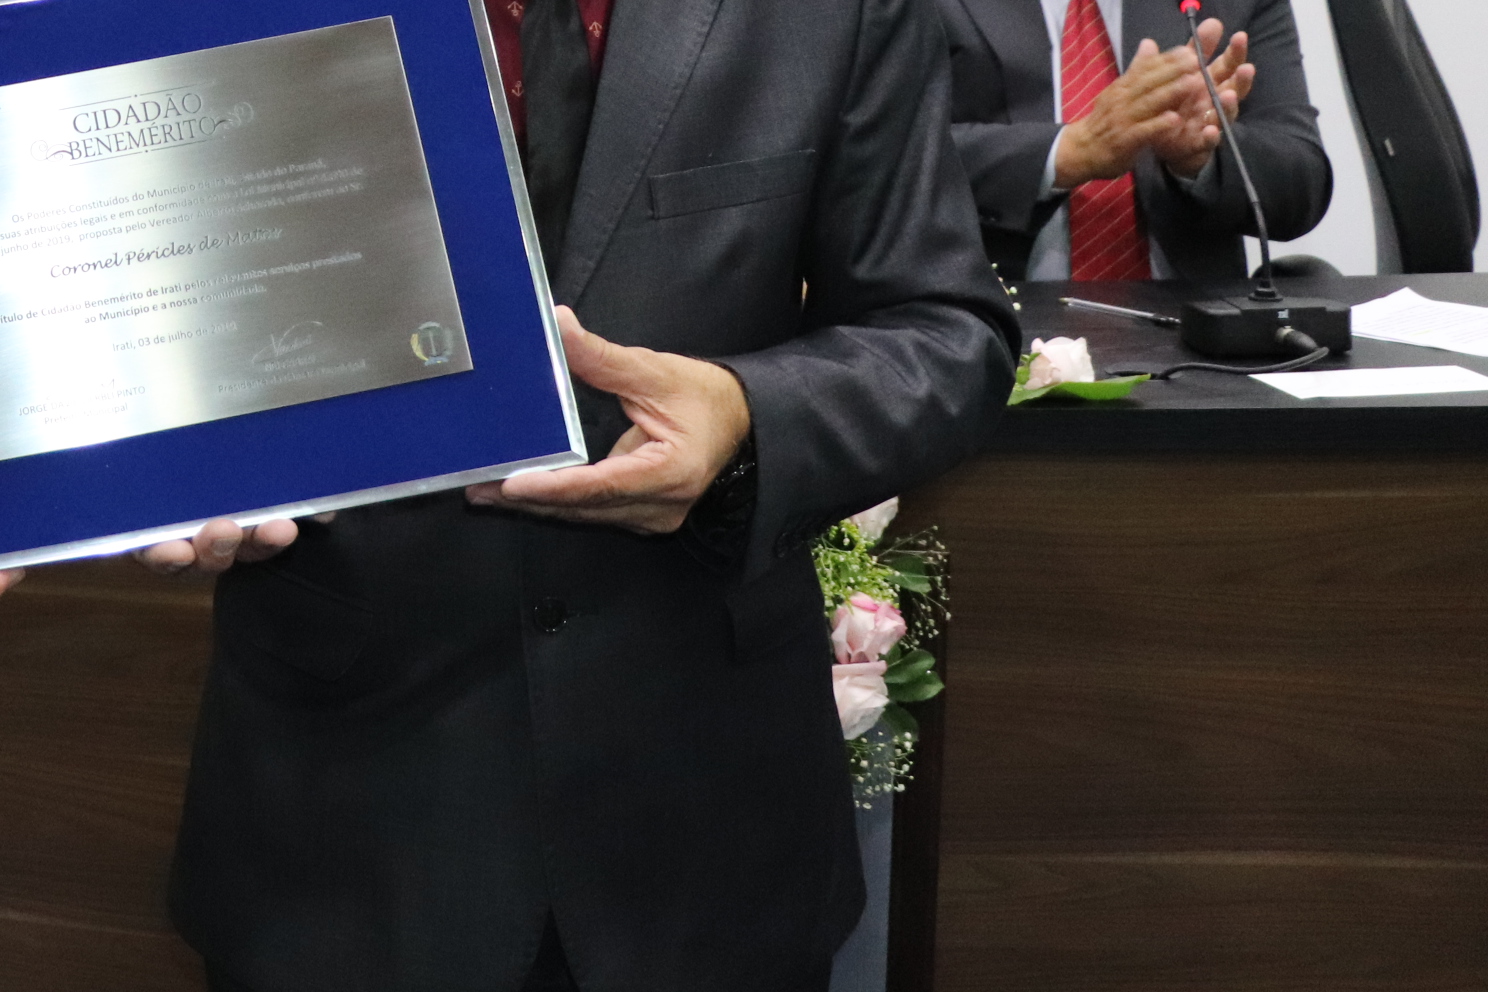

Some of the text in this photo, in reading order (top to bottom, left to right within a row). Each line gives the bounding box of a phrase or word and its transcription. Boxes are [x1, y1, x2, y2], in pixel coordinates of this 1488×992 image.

[71, 91, 203, 134] CIDADÃO
[68, 114, 217, 160] BENEMÉRITO
[0, 230, 21, 240] suas
[23, 220, 77, 235] atribuições
[79, 213, 108, 226] legais
[118, 209, 134, 218] em
[136, 195, 205, 215] conformidade
[11, 214, 24, 223] Os
[26, 207, 66, 221] Poderes
[68, 196, 130, 213] Constituídos
[131, 192, 145, 202] do
[146, 183, 196, 199] Município
[0, 242, 28, 256] junho
[30, 240, 43, 249] de
[79, 226, 122, 242] proposta
[125, 221, 146, 233] pelo
[149, 213, 193, 227] Vereador
[49, 252, 124, 279] Coronel
[124, 242, 196, 265] Péricles
[197, 235, 224, 251] de
[25, 310, 38, 319] de
[83, 290, 143, 309] Benemérito
[145, 287, 159, 297] de
[160, 282, 182, 295] Irati
[184, 279, 211, 292] pelos
[83, 315, 96, 324] ao
[98, 304, 149, 320] Município
[151, 303, 158, 311] e
[160, 302, 166, 310] a
[169, 296, 198, 308] nossa
[112, 340, 136, 352] Irati,
[137, 336, 151, 347] 03
[152, 335, 166, 345] de
[167, 329, 193, 343] julho
[195, 327, 208, 336] de
[18, 402, 47, 416] JORGE
[116, 385, 146, 399] PINTO
